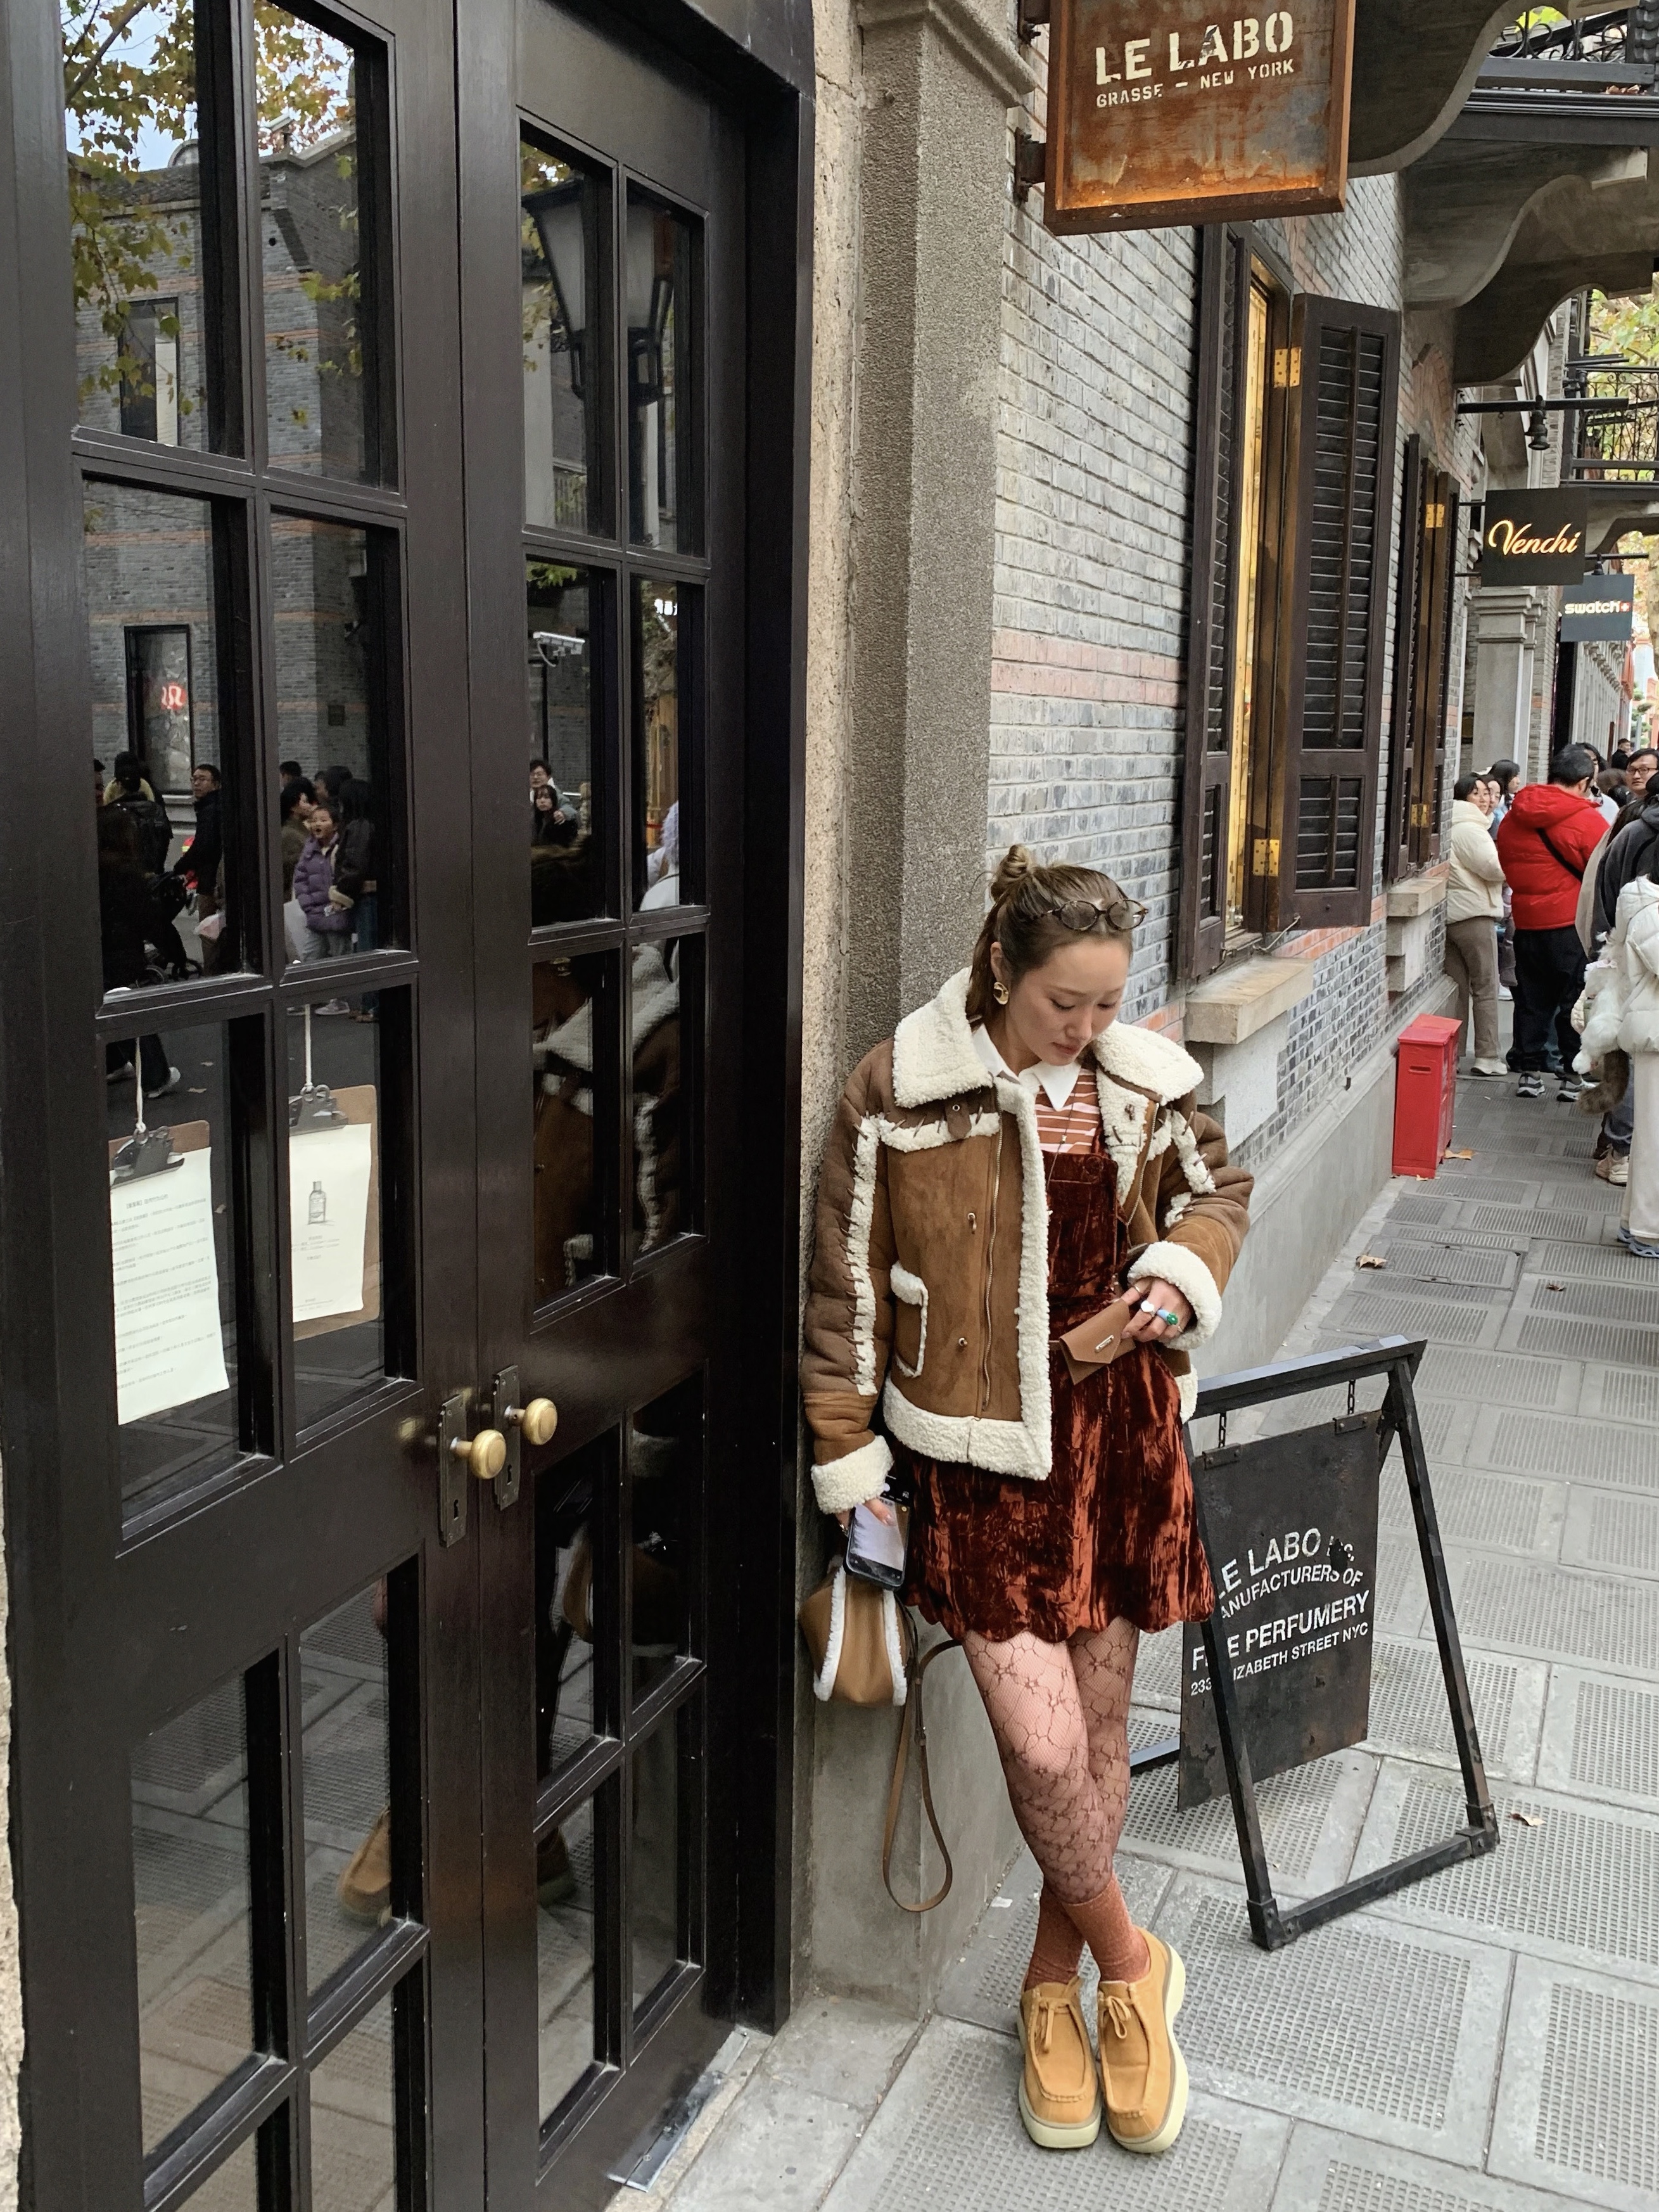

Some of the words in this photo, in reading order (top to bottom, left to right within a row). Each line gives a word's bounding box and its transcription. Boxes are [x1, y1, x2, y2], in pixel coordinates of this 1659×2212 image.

[1096, 38, 1152, 85] LE
[1169, 11, 1293, 71] LABO
[1096, 84, 1163, 108] GRASSE
[1200, 70, 1234, 89] NEW
[1248, 58, 1294, 80] YORK
[1489, 520, 1582, 555] Venchi
[1565, 601, 1620, 614] swatch
[1248, 1528, 1321, 1576] LABO
[1221, 1564, 1340, 1619] ANUFACTURERS
[1343, 1568, 1363, 1587] OF
[1245, 1590, 1370, 1653] PERFUMERY
[1233, 1650, 1288, 1680] IZABETH
[1292, 1632, 1340, 1660] STREET
[1343, 1622, 1368, 1642] NYC
